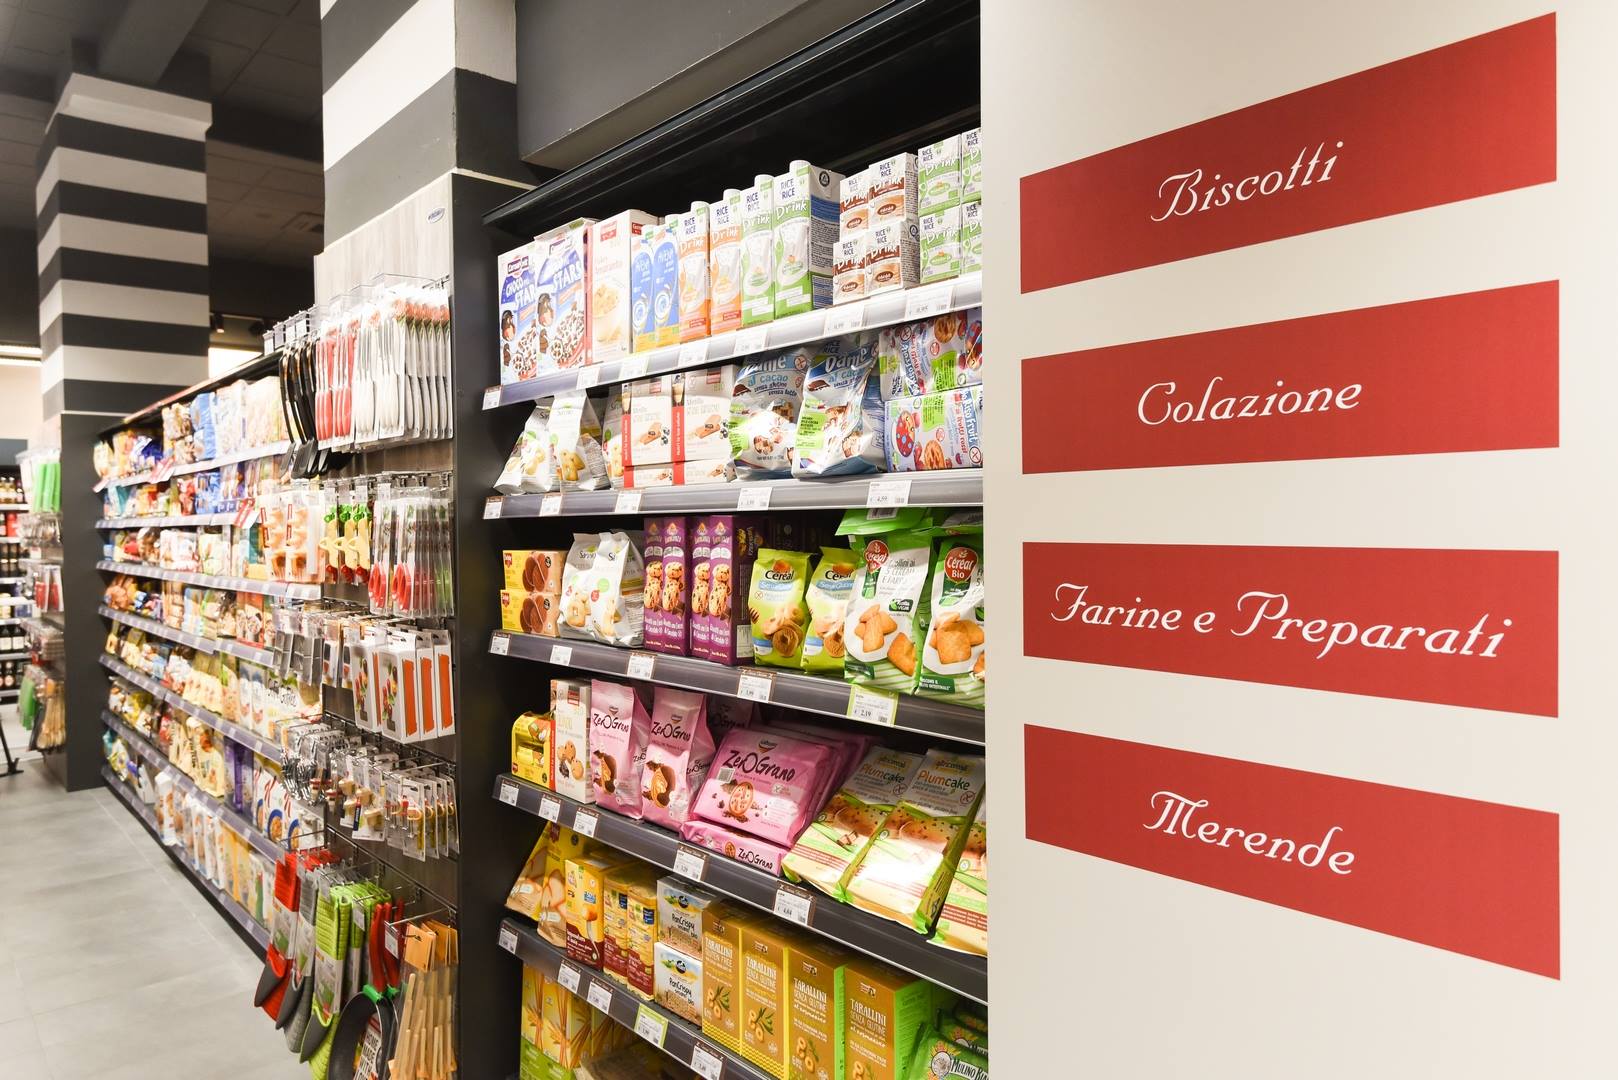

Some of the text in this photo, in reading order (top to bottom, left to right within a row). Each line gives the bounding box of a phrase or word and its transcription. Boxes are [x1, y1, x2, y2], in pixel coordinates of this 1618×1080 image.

[1151, 141, 1344, 222] Biscotti
[1138, 377, 1361, 424] Colazione
[943, 556, 974, 571] Céréal
[951, 569, 965, 579] Bio
[1051, 583, 1512, 659] Farine e Preparati
[862, 763, 905, 784] Plumcake
[919, 769, 971, 791] Plumcake
[1143, 791, 1355, 875] Merende
[793, 977, 827, 1004] TARALLINI
[850, 998, 887, 1027] TARALLINI
